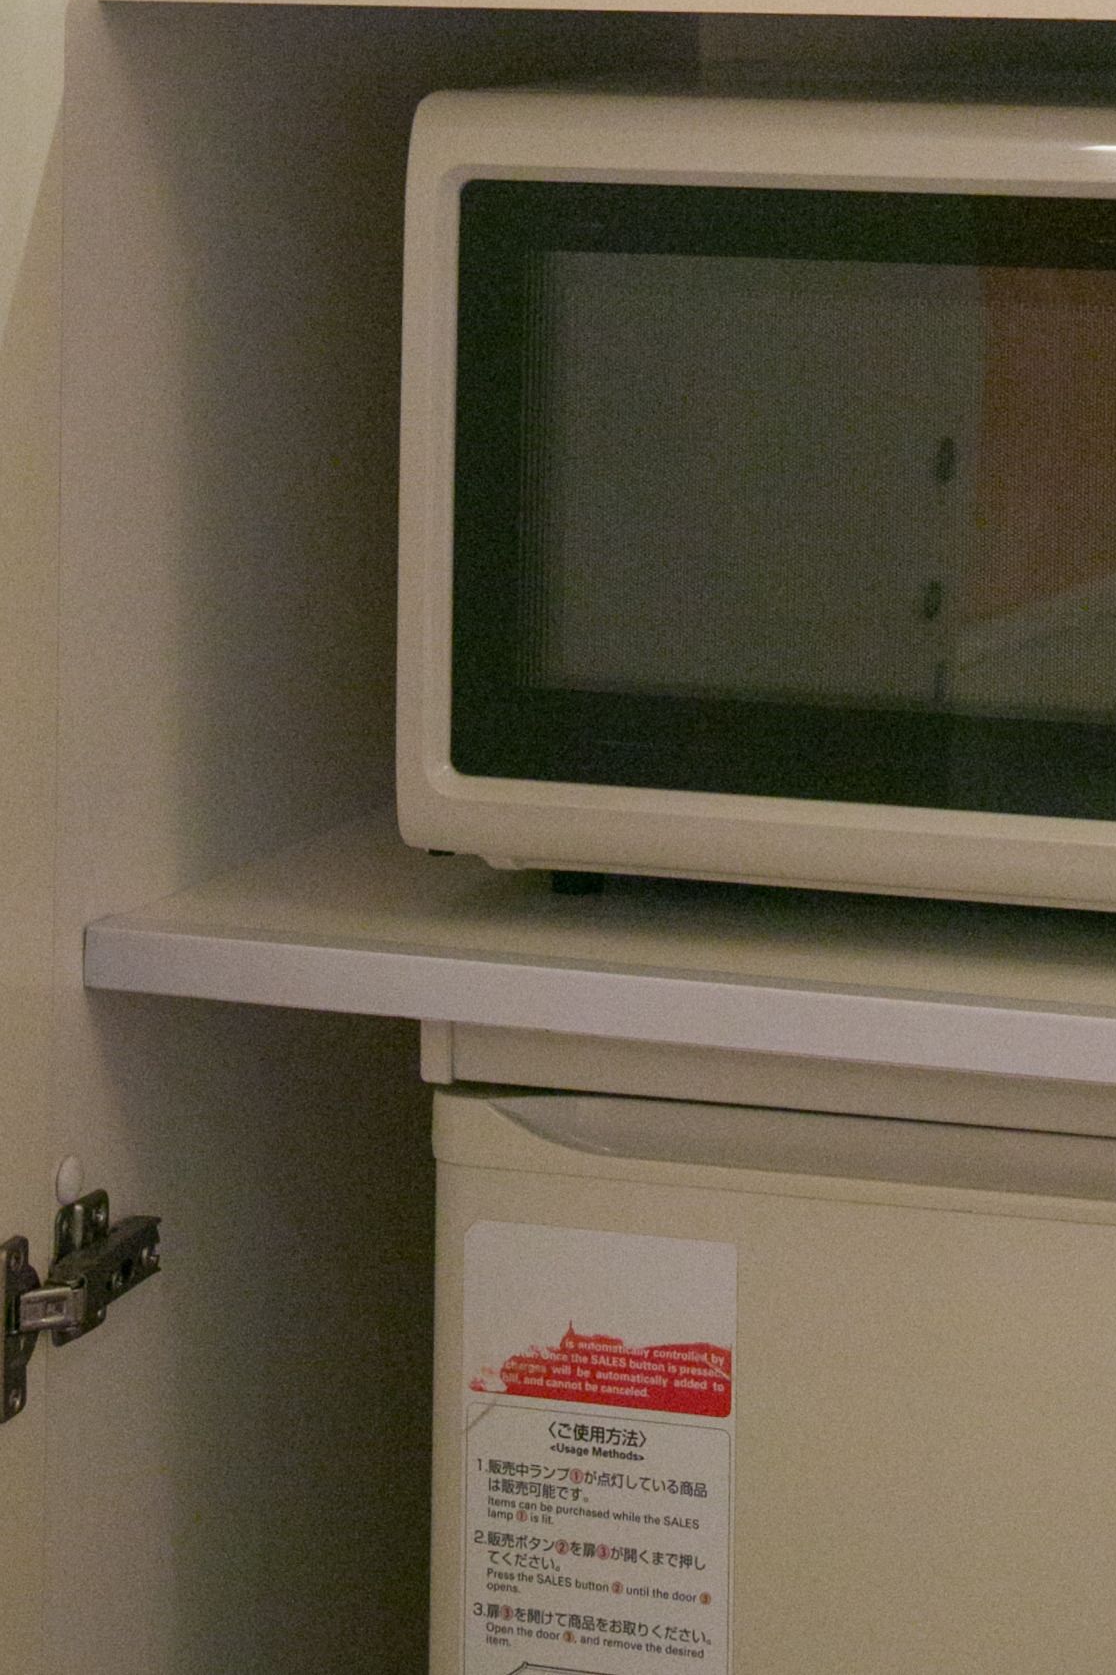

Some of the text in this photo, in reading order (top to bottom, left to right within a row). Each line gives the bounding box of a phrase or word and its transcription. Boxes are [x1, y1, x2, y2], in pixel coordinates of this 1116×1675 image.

[571, 1353, 588, 1364] the
[591, 1355, 627, 1368] SALES
[629, 1359, 665, 1372] button
[523, 1375, 544, 1386] and
[545, 1379, 582, 1390] cannot
[585, 1382, 598, 1393] be
[551, 1365, 572, 1376] will
[577, 1366, 591, 1378] be
[596, 1371, 668, 1387] automatically
[674, 1378, 707, 1390] added
[713, 1382, 725, 1393] to
[488, 1477, 589, 1503] は販売可能です。
[487, 1508, 513, 1521] lamp
[530, 1513, 539, 1523] is
[488, 1496, 700, 1530] Items can be purchased while the SALES
[488, 1550, 560, 1572] てください。
[487, 1568, 515, 1580] Press
[518, 1572, 534, 1583] the
[536, 1574, 572, 1588] SALES
[575, 1579, 609, 1592] button
[626, 1586, 649, 1597] until
[652, 1589, 669, 1599] the
[672, 1591, 697, 1603] door
[486, 1622, 514, 1635] Open
[517, 1627, 533, 1638] the
[536, 1628, 560, 1640] door
[580, 1636, 600, 1646] and
[603, 1638, 643, 1651] remove
[646, 1642, 662, 1654] the
[665, 1645, 705, 1659] desired
